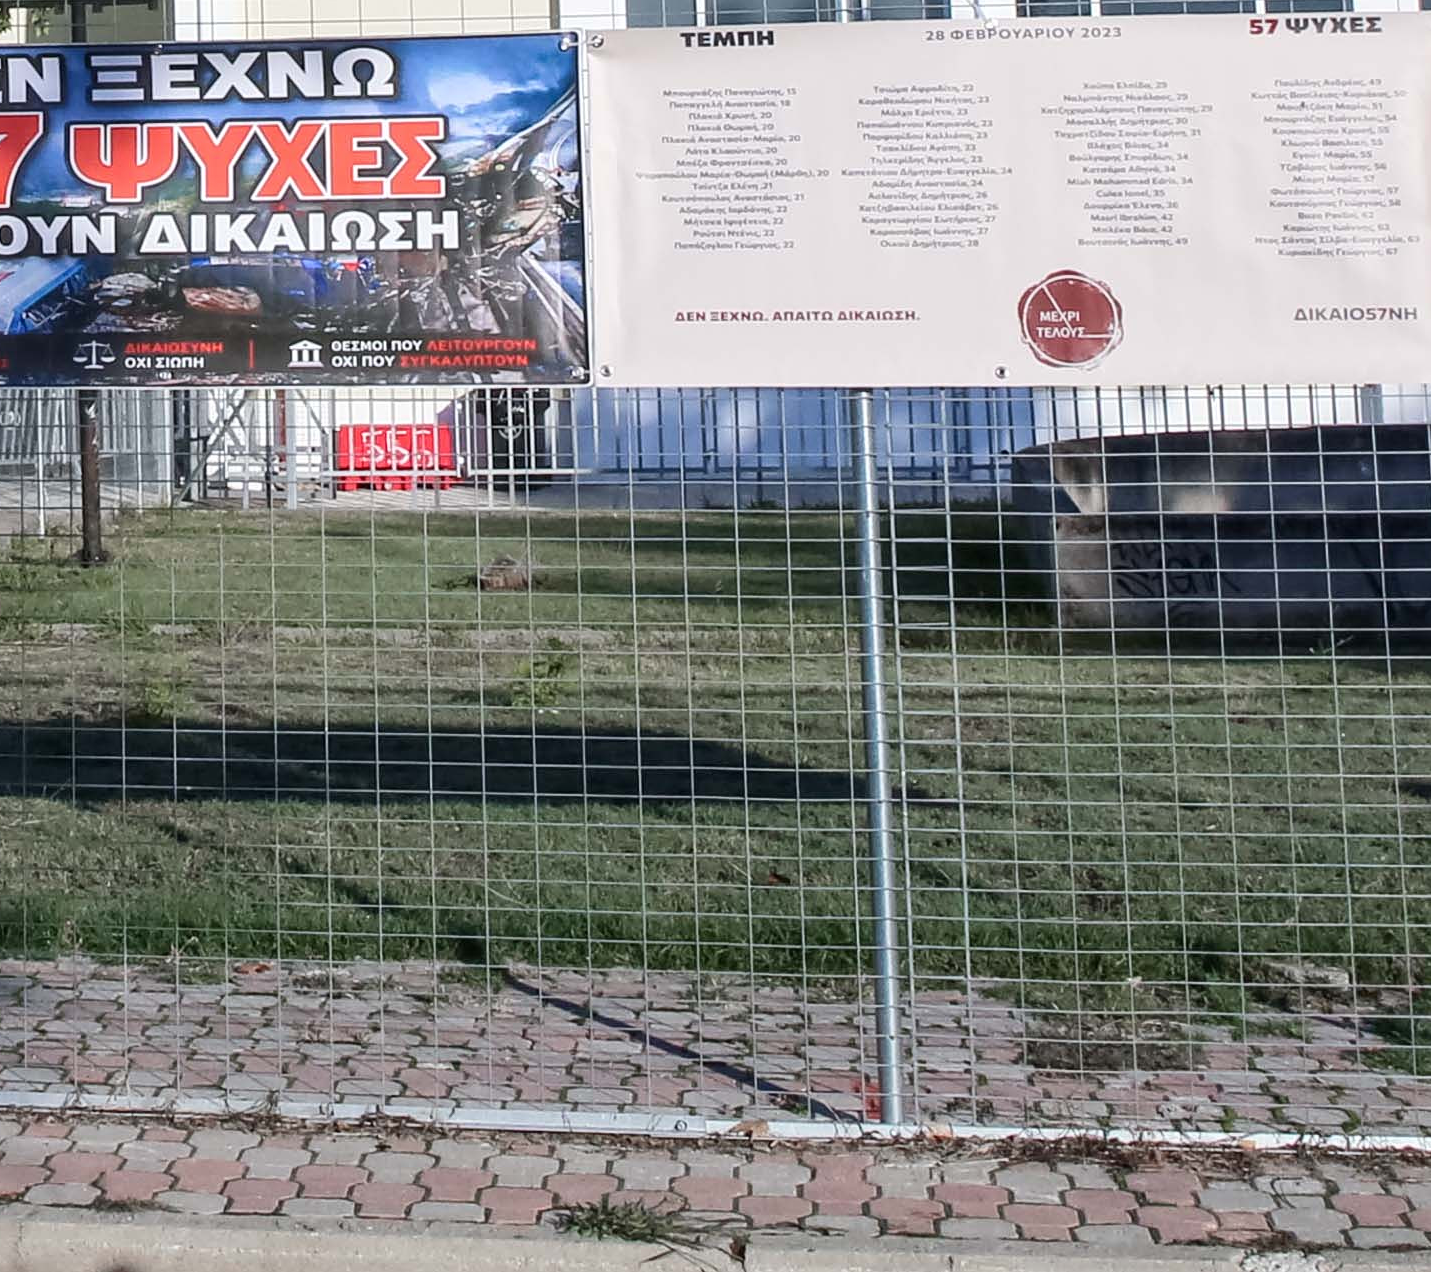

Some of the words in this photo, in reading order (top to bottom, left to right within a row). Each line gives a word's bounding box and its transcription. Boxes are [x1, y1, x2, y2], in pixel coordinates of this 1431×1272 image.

[1249, 18, 1280, 36] 57
[1285, 16, 1383, 35] ΨΥΧΕΣ
[680, 32, 775, 49] ΤΕΜΠΗ
[925, 30, 945, 43] 28
[949, 27, 1077, 43] ΦΕΒΡΟΥΑΡΙΟΥ
[1080, 26, 1123, 39] 2023
[90, 49, 397, 103] ΞΕΧΝΩ
[69, 116, 447, 202] ΨΥΧΕΣ
[139, 210, 459, 254] ΔΙΚΑΙΩΣΗ
[674, 311, 706, 322] ΔΕΝ
[710, 311, 769, 322] ΞΕΧΝΩ.
[772, 311, 833, 322] ΑΠΑΙΤΩ
[837, 310, 921, 321] ΔΙΚΑΙΩΣΗ.
[1040, 311, 1080, 322] ΜΕΧΡΙ
[1293, 307, 1418, 323] ΔΙΚΑΙΟ57ΝΗ
[1036, 327, 1085, 338] ΤΕΛΟΥΣ
[124, 341, 224, 354] ΔΙΚΑΙΟΣΥΝΗ
[331, 340, 387, 352] ΘΕΣΜΟΙ
[391, 340, 422, 352] ΠΟΥ
[426, 339, 537, 351] ΛΕΙΤΟΥΡΓΟΥΝ
[124, 356, 152, 369] ΟΧΙ
[155, 356, 205, 369] ΣΙΩΠΗ
[331, 355, 358, 368] ΟΧΙ
[362, 355, 395, 368] ΠΟΥ
[400, 354, 530, 367] ΣΥΓΚΑΛΥΠΤΟΥΝ
